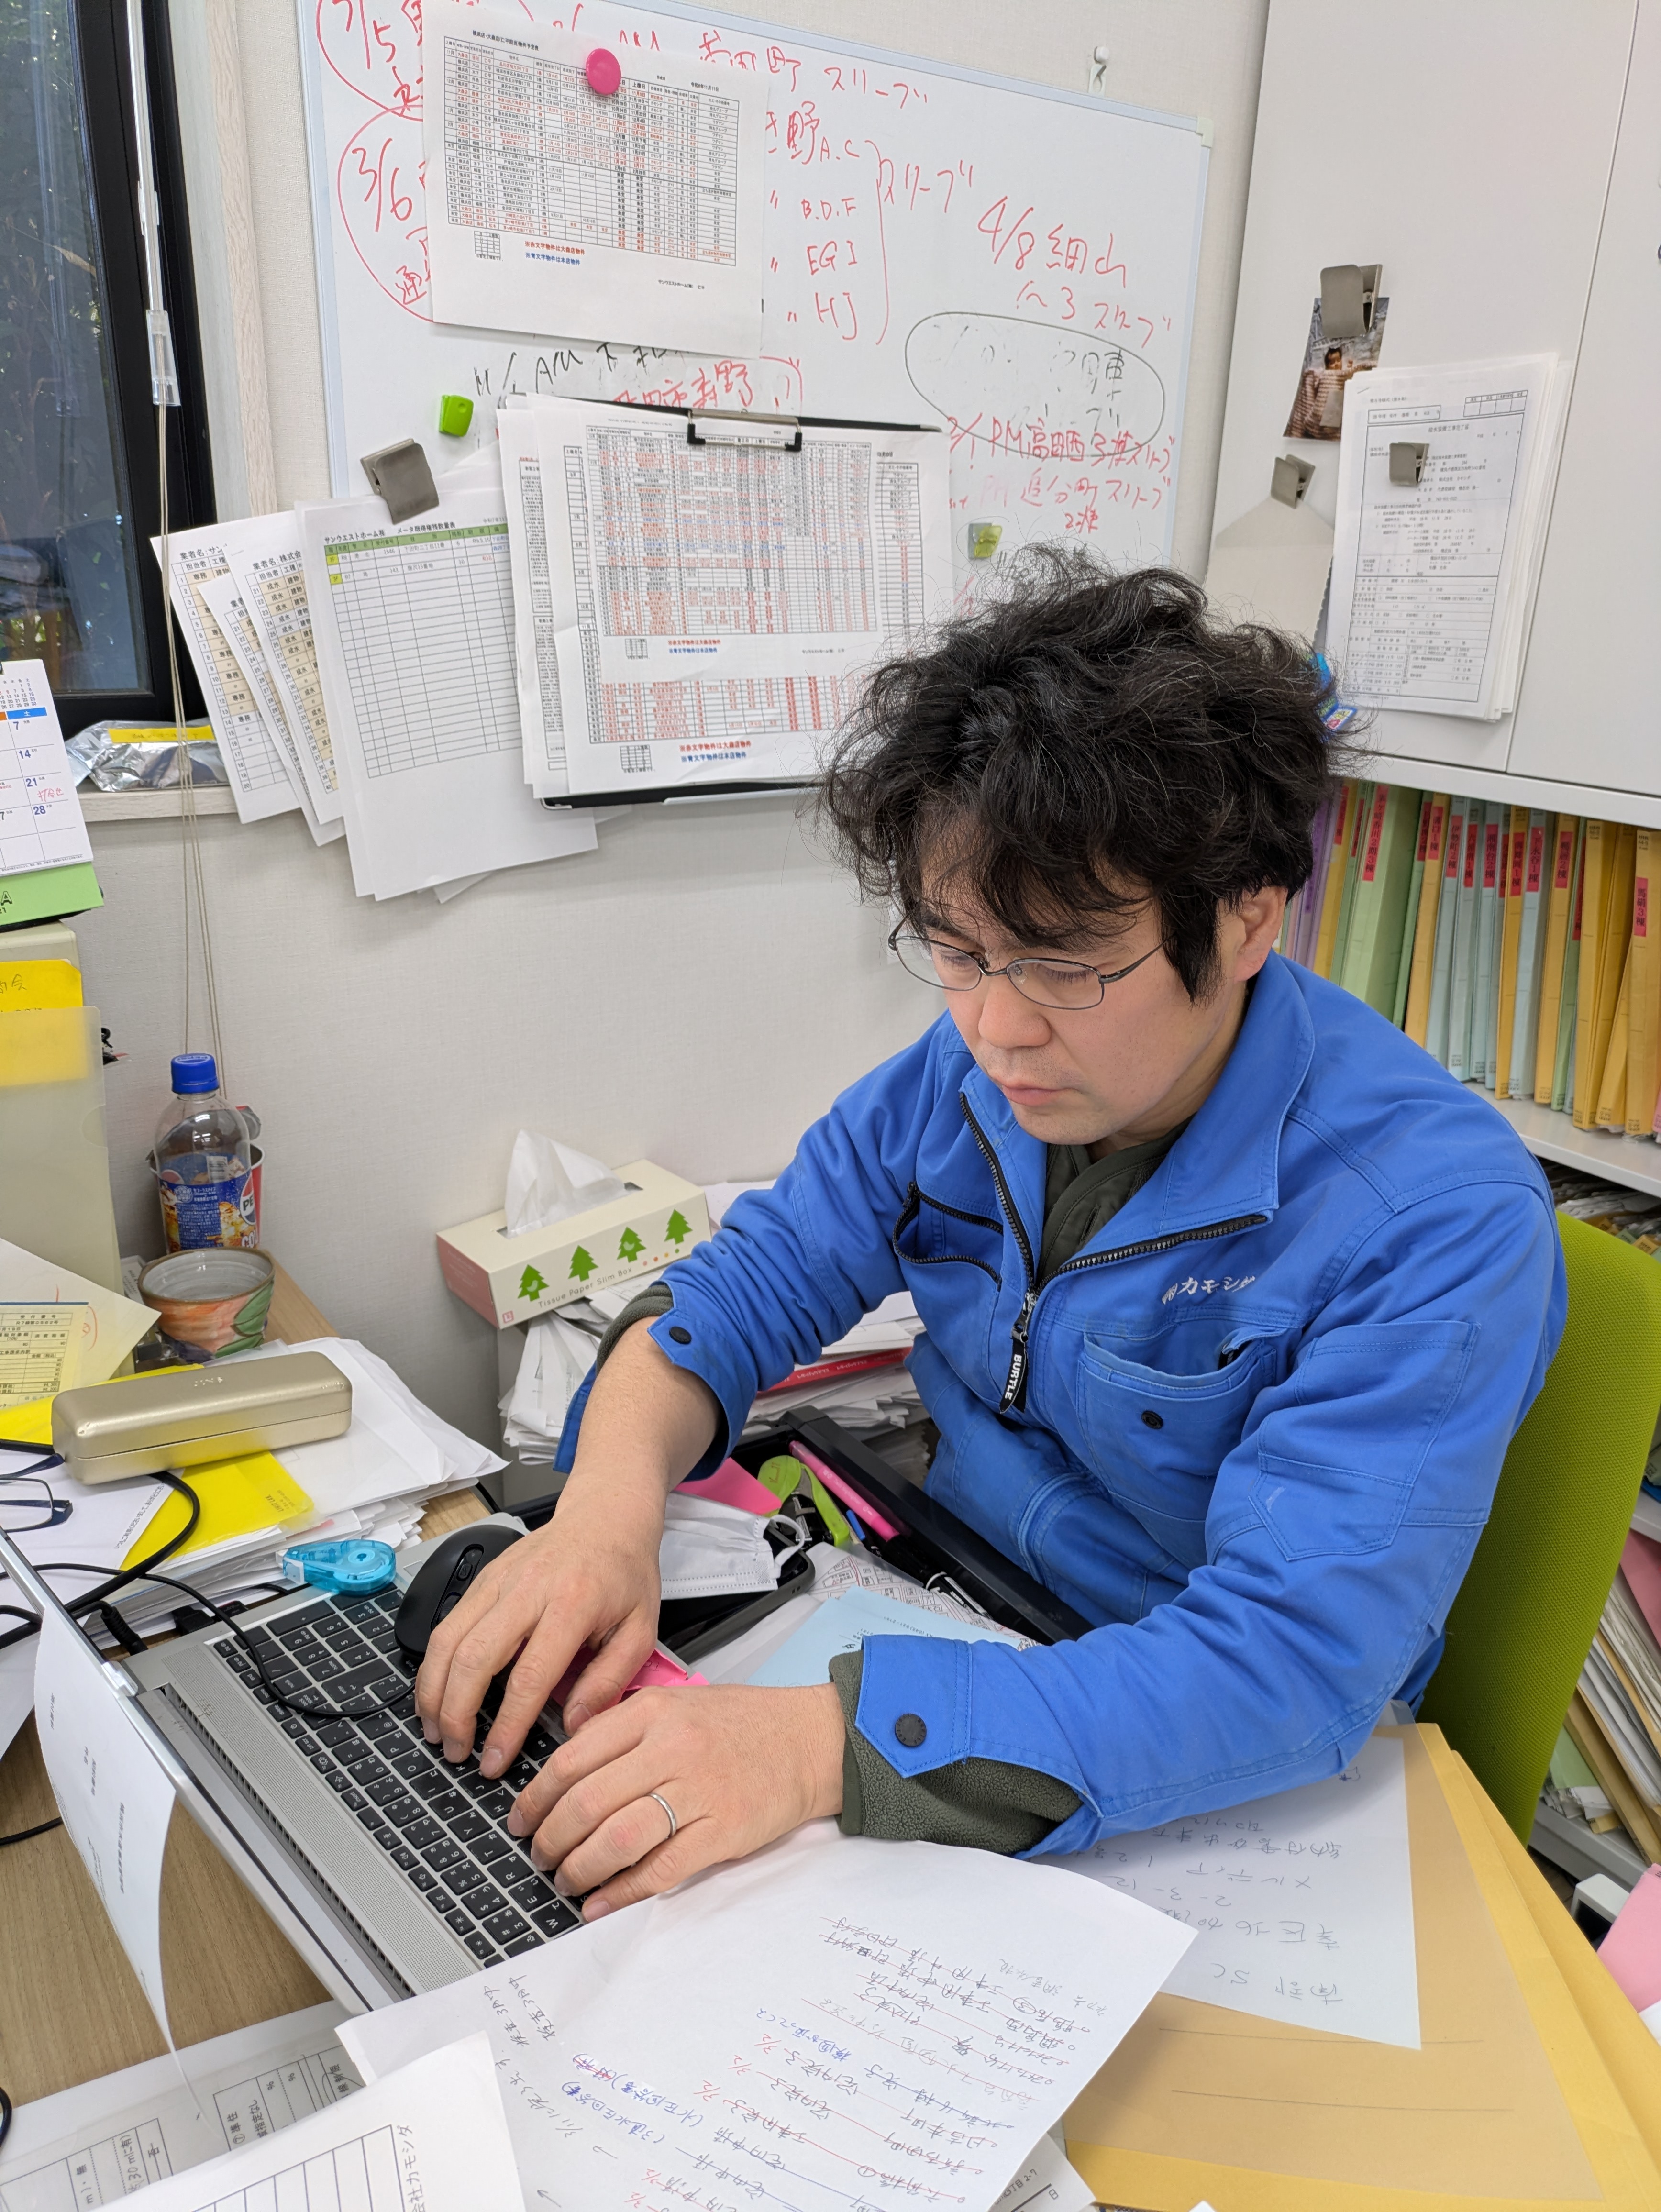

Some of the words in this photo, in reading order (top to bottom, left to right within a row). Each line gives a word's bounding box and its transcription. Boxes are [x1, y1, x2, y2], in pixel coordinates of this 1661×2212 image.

[352, 138, 412, 232] 3/6
[186, 561, 206, 570] 担当者
[259, 569, 279, 580] 担当者
[13, 721, 19, 730] 7
[19, 749, 31, 759] 14
[25, 777, 38, 787] 21
[33, 805, 46, 815] 28
[538, 1294, 565, 1308] Tissue
[569, 1283, 593, 1296] Paper
[597, 1274, 615, 1285] Slim
[618, 1268, 632, 1276] Box
[1004, 1354, 1022, 1400] BURTLE
[546, 1918, 559, 1929] W
